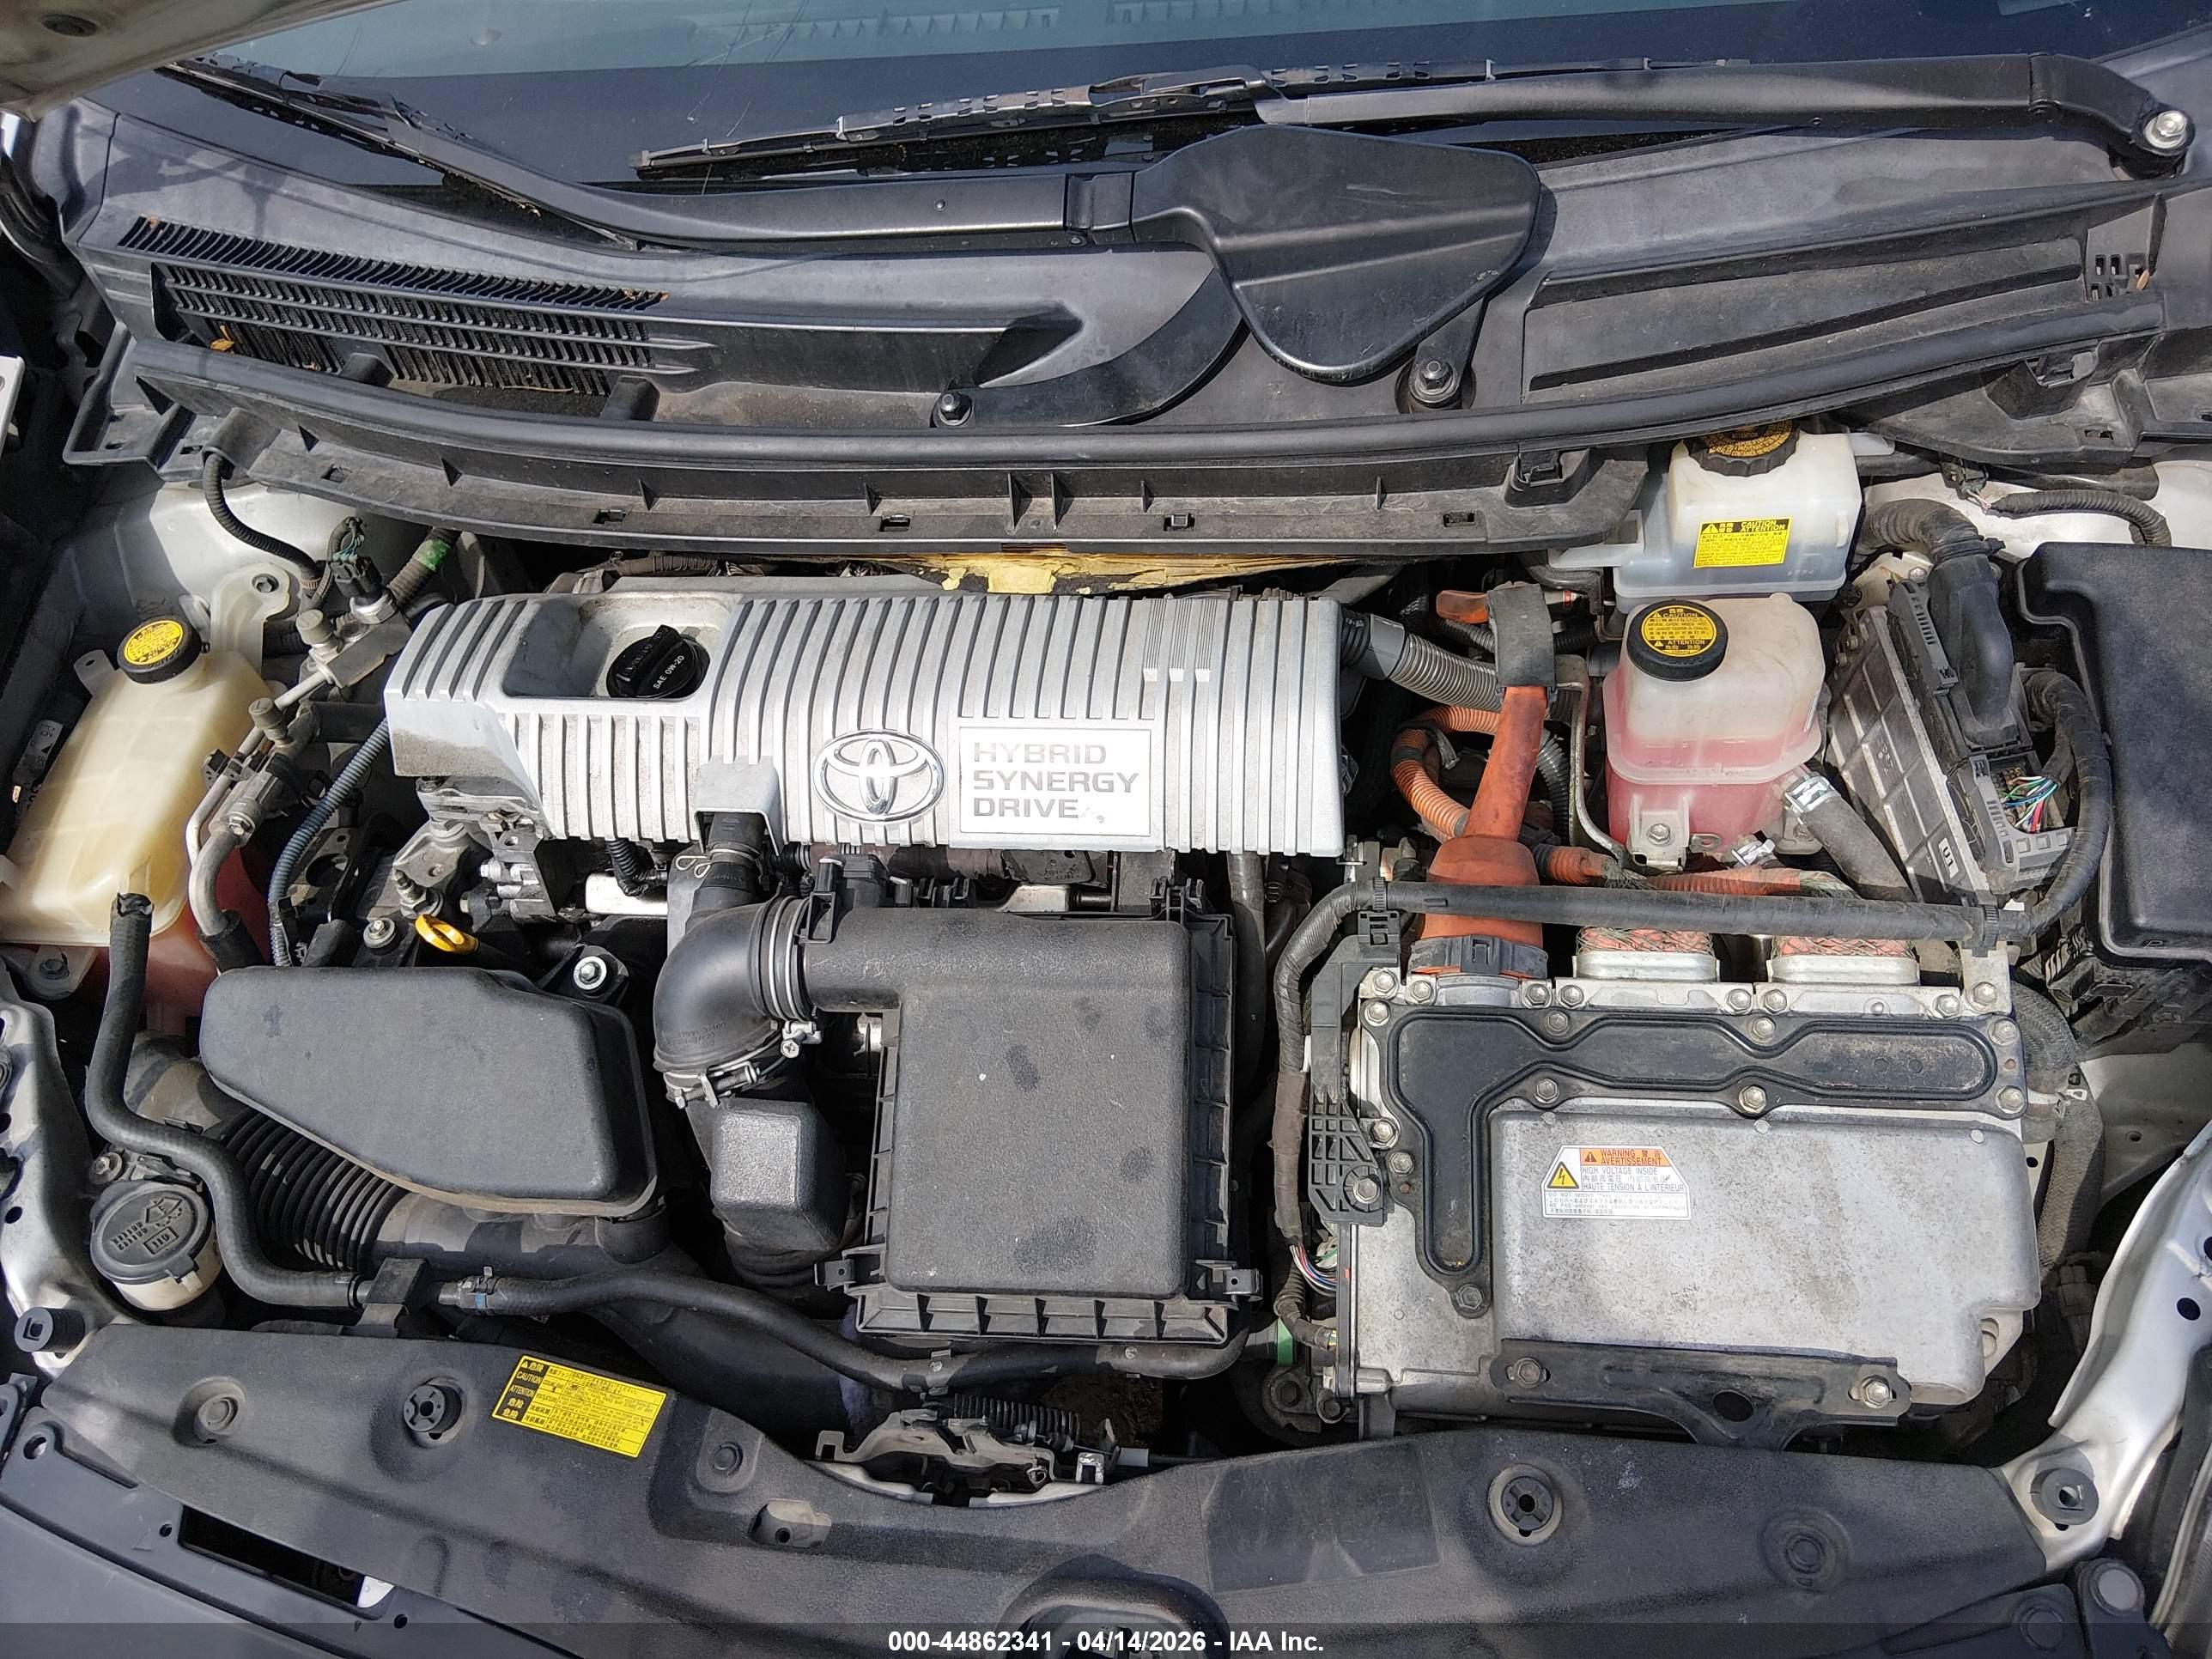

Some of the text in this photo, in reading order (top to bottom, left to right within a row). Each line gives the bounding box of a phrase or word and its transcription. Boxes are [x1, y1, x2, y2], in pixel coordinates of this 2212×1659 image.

[1741, 520, 1778, 528] CAUTION
[653, 676, 667, 690] SAE
[974, 742, 1106, 764] HYBRID
[974, 770, 1139, 793] SYNERGY
[974, 798, 1079, 818] DRIVE
[1601, 1149, 1636, 1158] WARNING
[516, 1371, 544, 1384] CAUTION
[509, 1384, 536, 1398] ATTENTION
